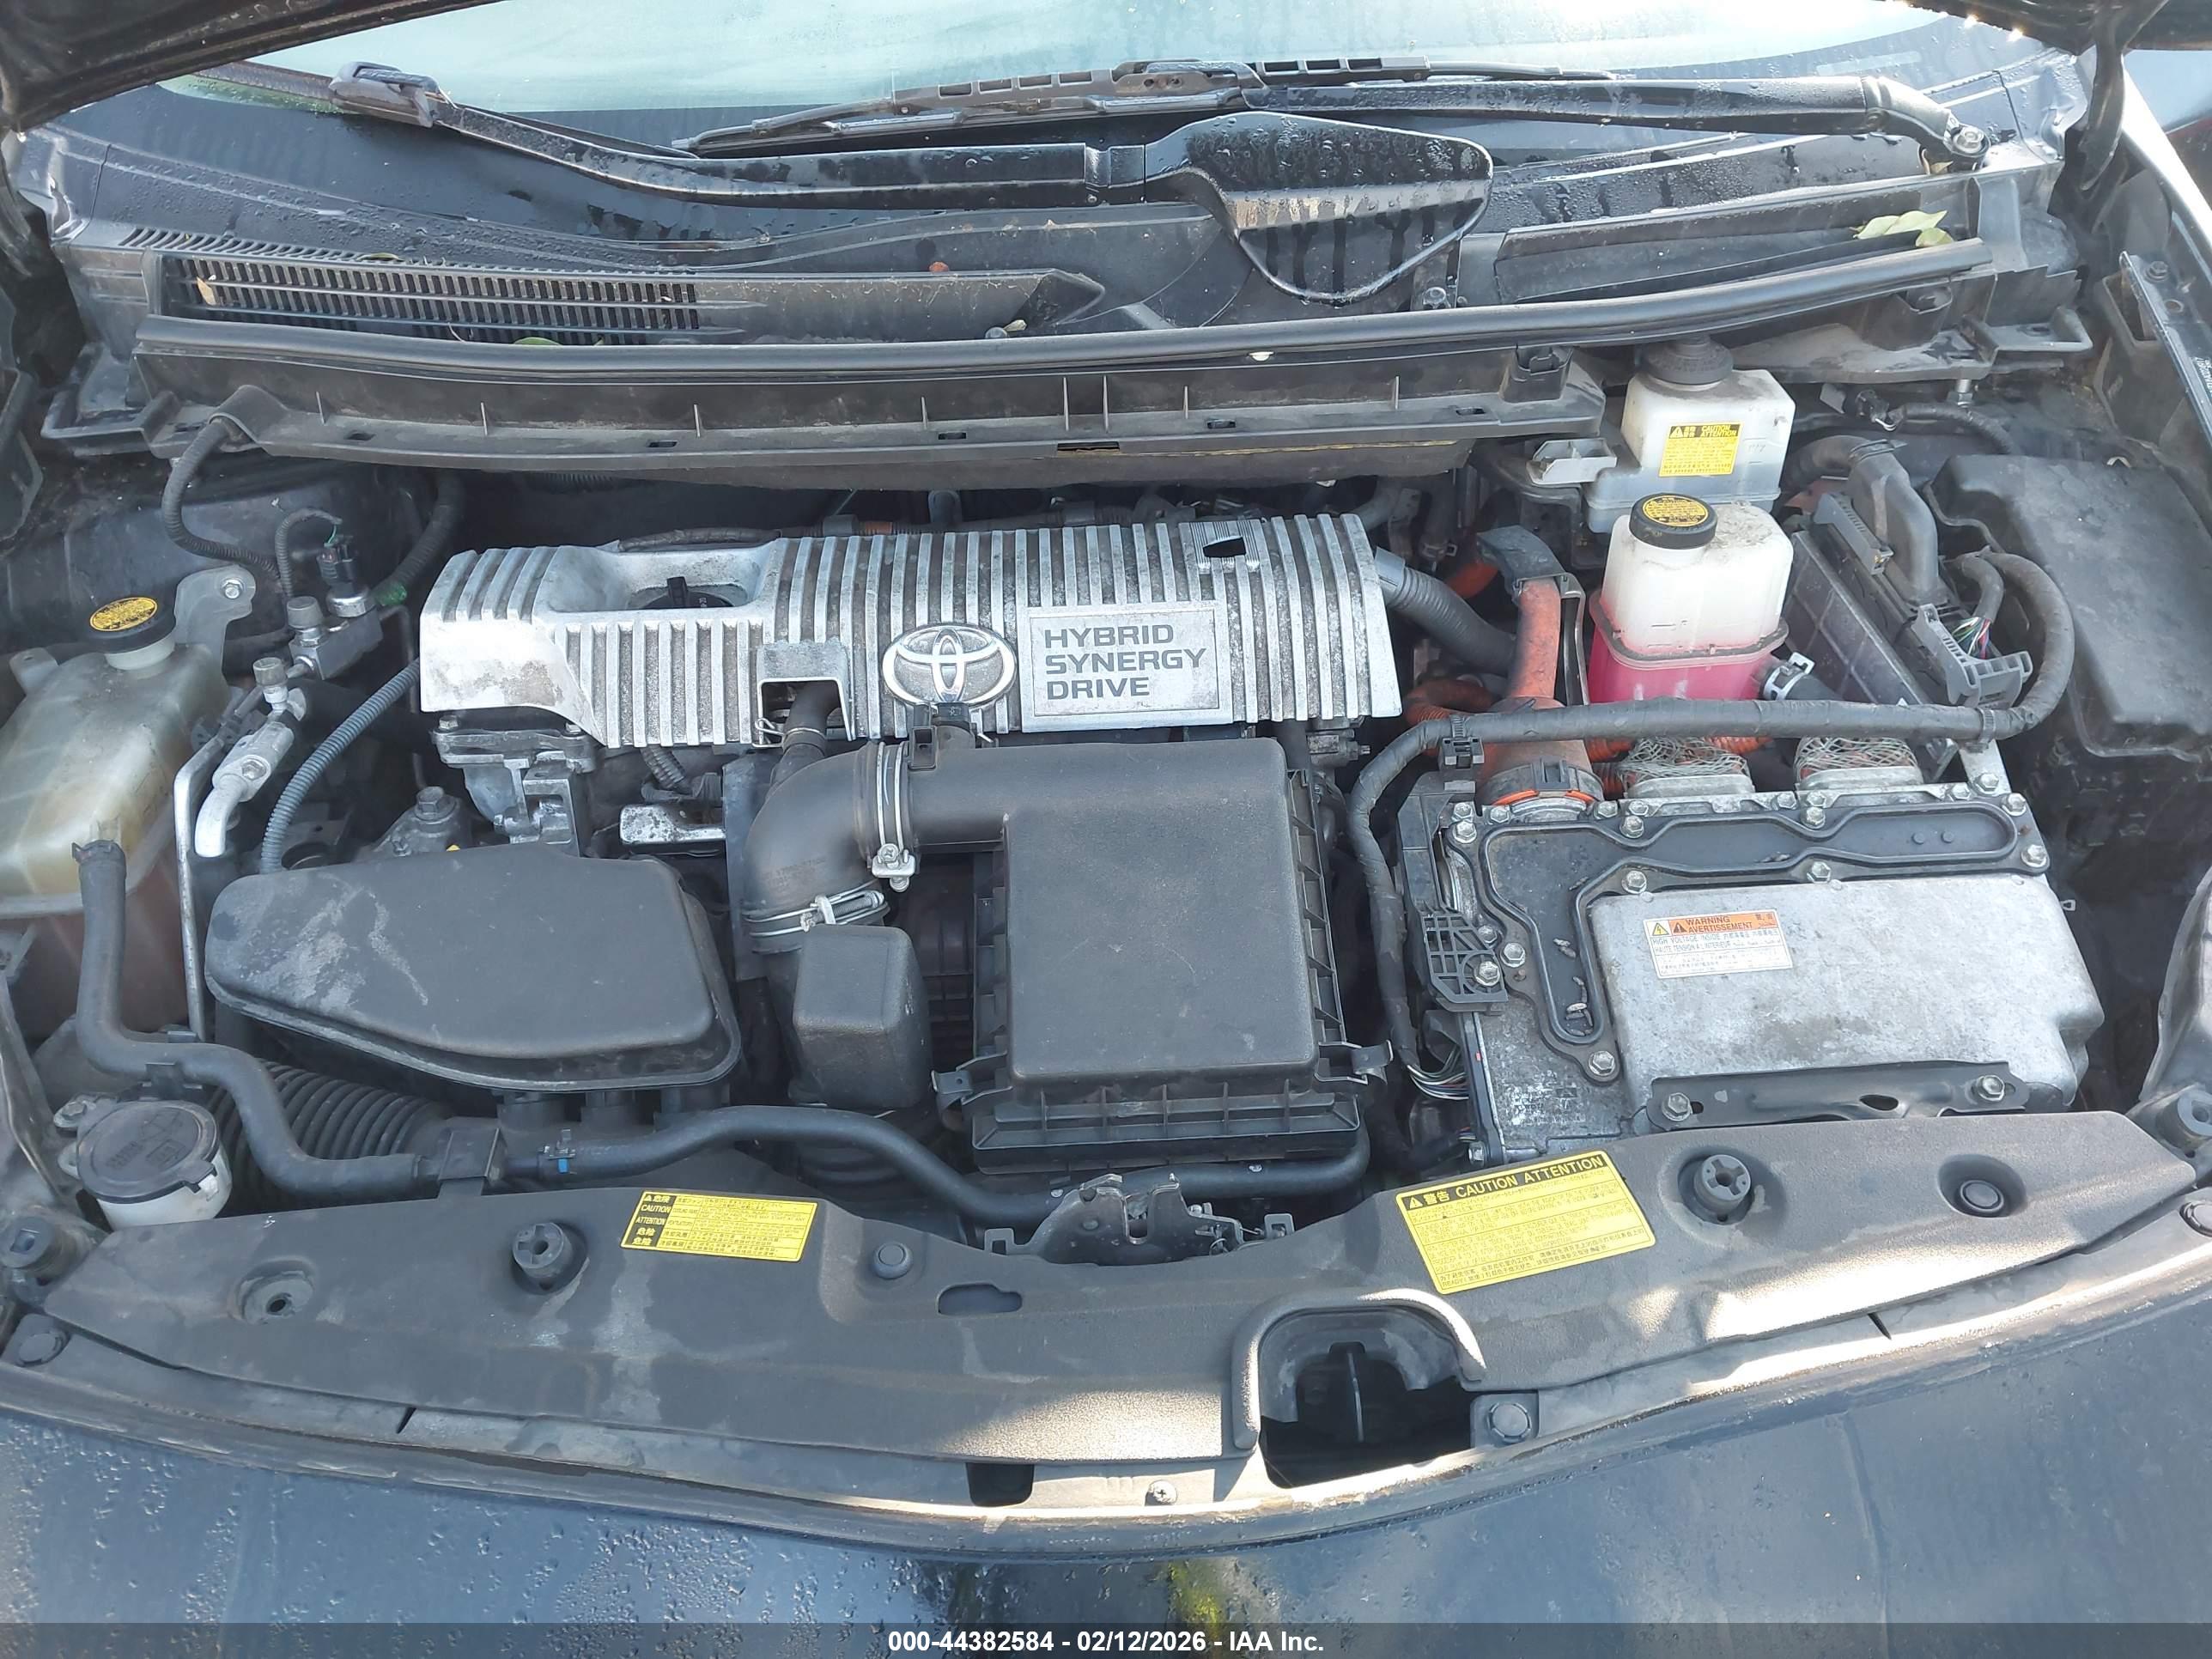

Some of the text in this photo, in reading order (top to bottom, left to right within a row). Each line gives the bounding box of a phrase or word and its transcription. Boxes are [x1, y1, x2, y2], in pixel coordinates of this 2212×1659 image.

[1044, 624, 1174, 648] HYBRID
[1045, 647, 1206, 675] SYNERGY
[1047, 677, 1150, 700] DRIVE
[1685, 915, 1730, 926] WARNING
[1688, 922, 1753, 933] AVERTISSEMENT
[1424, 1155, 1604, 1206] 警告 CAUTION ATTENTION
[641, 1205, 672, 1213] CAUTION
[635, 1217, 665, 1226] ATTENTION
